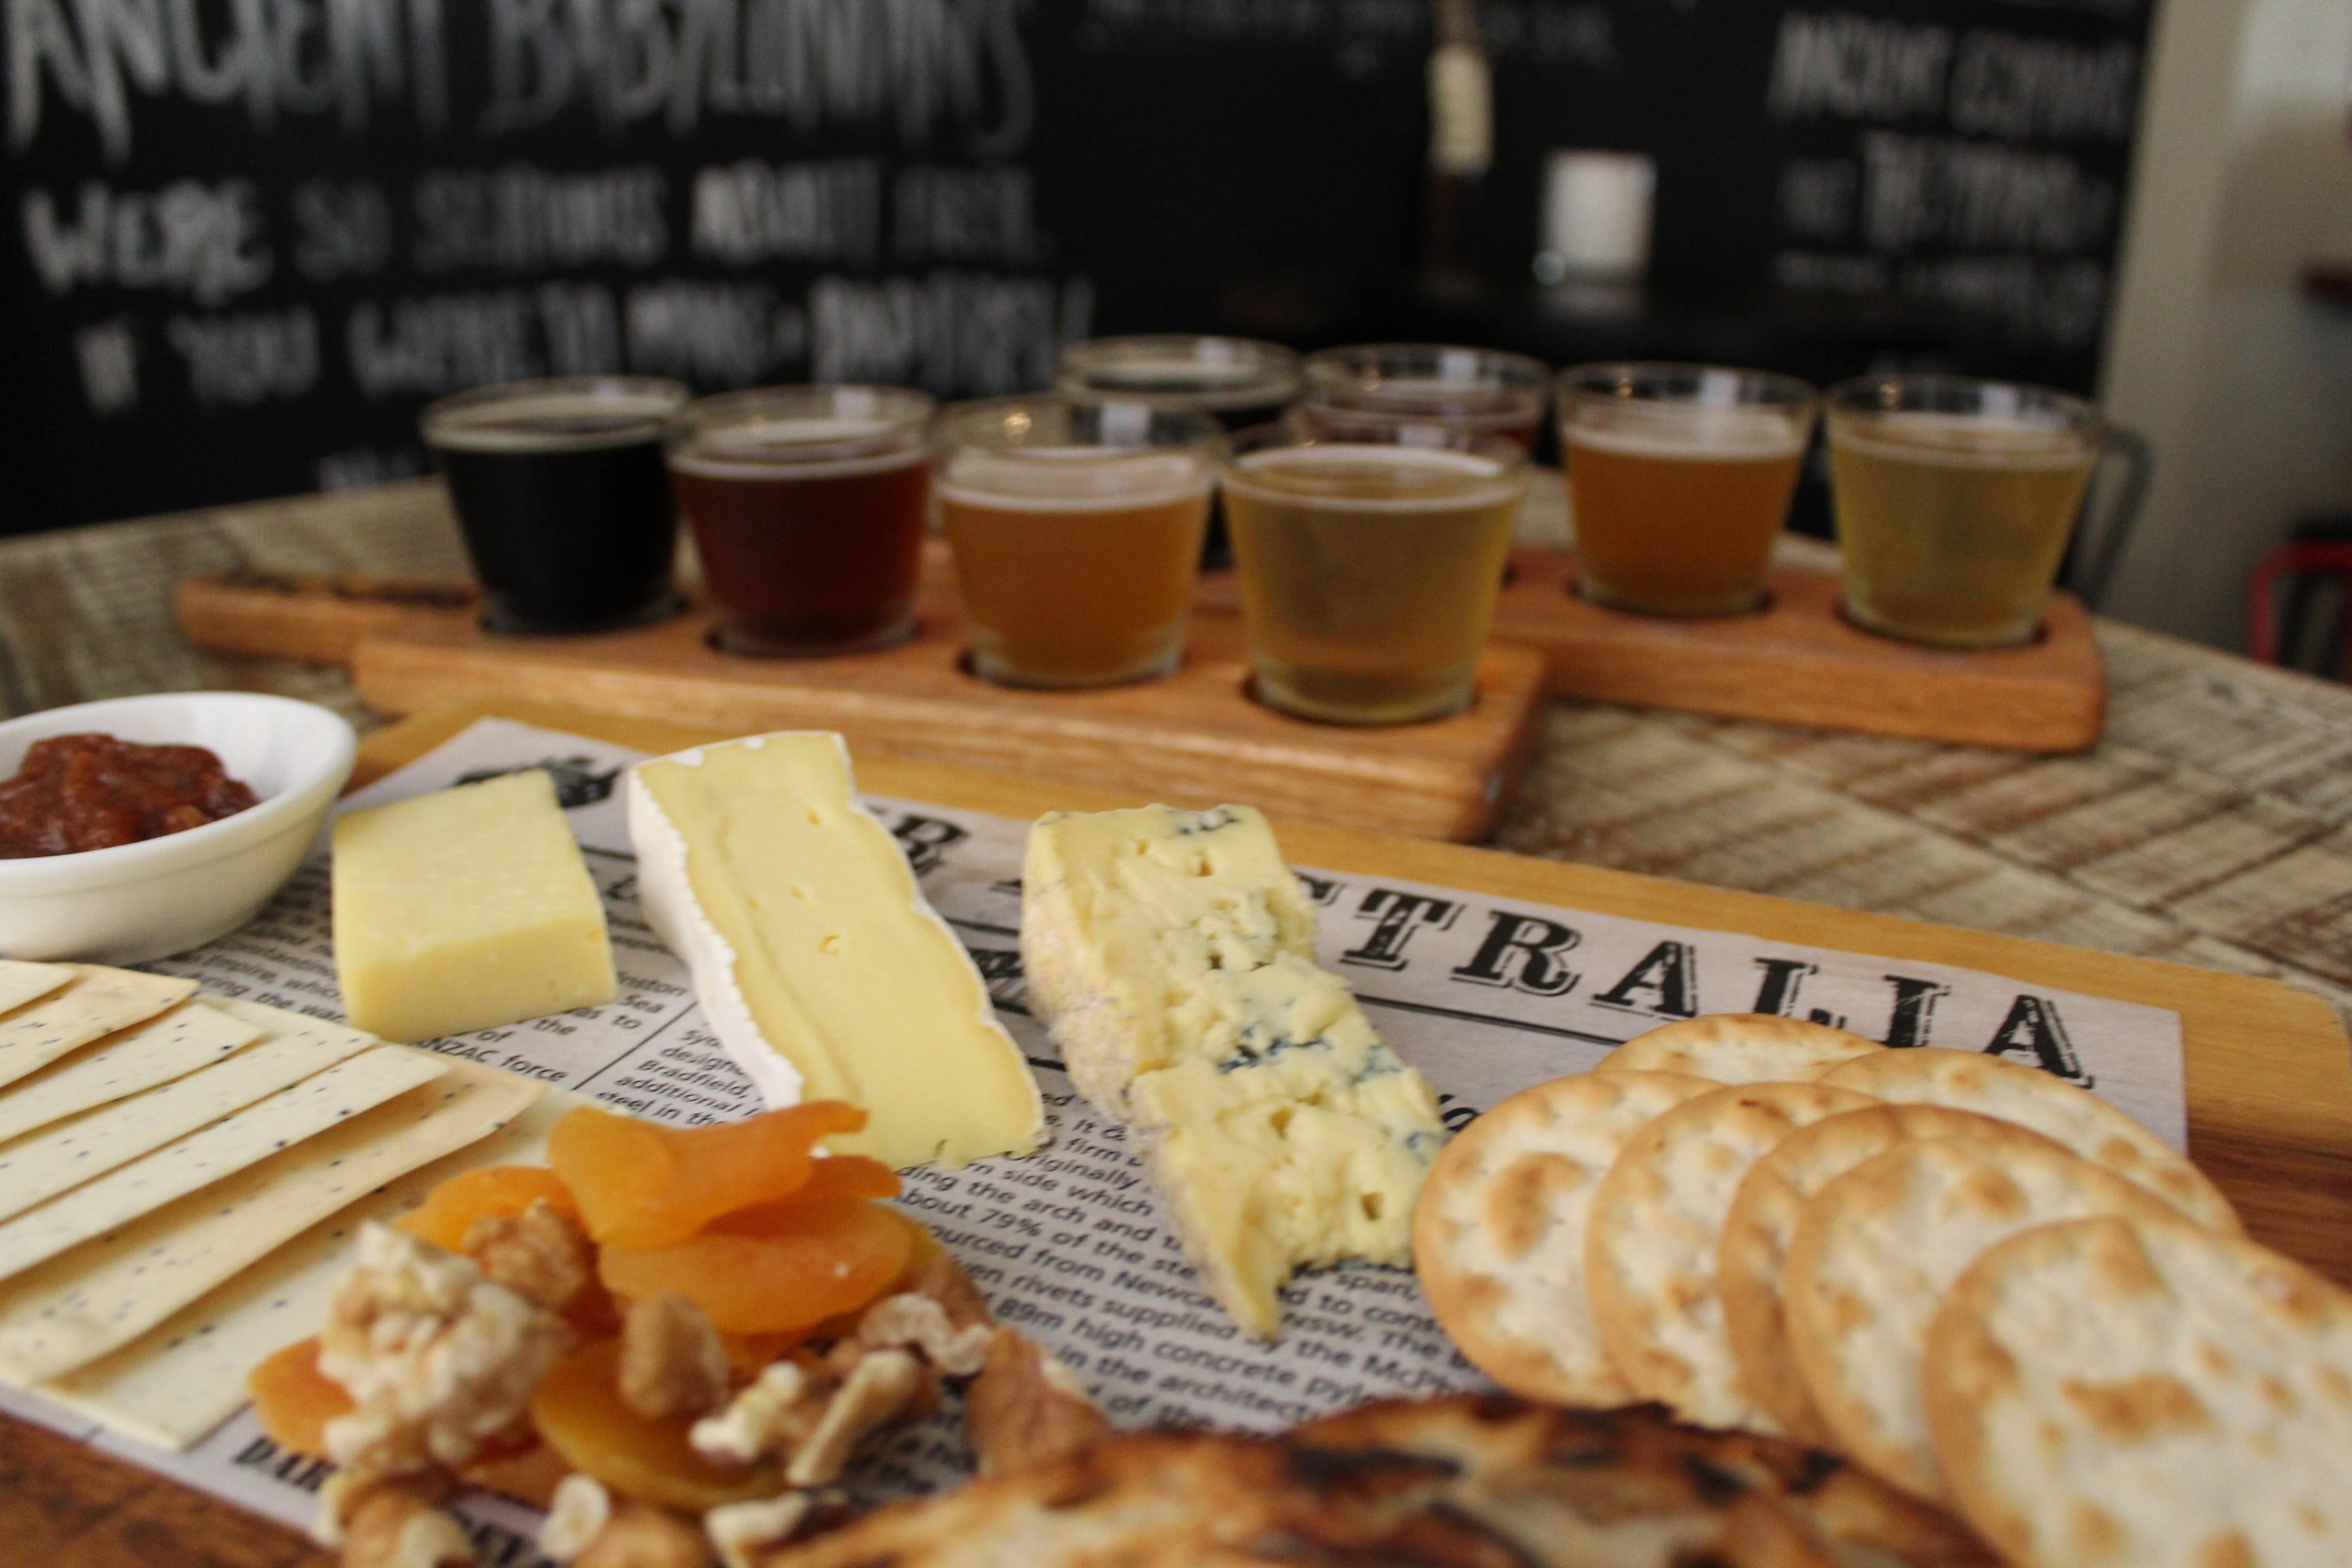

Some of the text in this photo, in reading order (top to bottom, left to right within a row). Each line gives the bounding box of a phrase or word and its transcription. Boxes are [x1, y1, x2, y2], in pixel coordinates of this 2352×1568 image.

[532, 1018, 578, 1036] the
[612, 1014, 642, 1029] to
[500, 1054, 569, 1082] force
[634, 1058, 755, 1100] Bradfield,
[660, 1047, 746, 1076] design
[612, 1075, 746, 1113] additional
[651, 1101, 683, 1120] in
[1062, 1137, 1124, 1164] firm
[894, 1164, 960, 1192] ding
[966, 1181, 1017, 1205] the
[1022, 1198, 1088, 1226] arch
[1092, 1218, 1158, 1243] and
[999, 1169, 1060, 1192] side
[1066, 1186, 1155, 1218] which
[894, 1188, 973, 1220] bout
[977, 1207, 1044, 1240] 79%
[1050, 1230, 1092, 1250] of
[1094, 1239, 1147, 1264] the
[1152, 1258, 1199, 1281] ste
[1031, 1248, 1107, 1282] from
[1110, 1269, 1229, 1315] Newca
[1010, 1273, 1096, 1311] rivets
[1098, 1296, 1241, 1342] supplied
[1294, 1339, 1354, 1367] the
[1069, 1315, 1146, 1352] high
[1152, 1337, 1298, 1386] concrete
[1094, 1358, 1153, 1386] the
